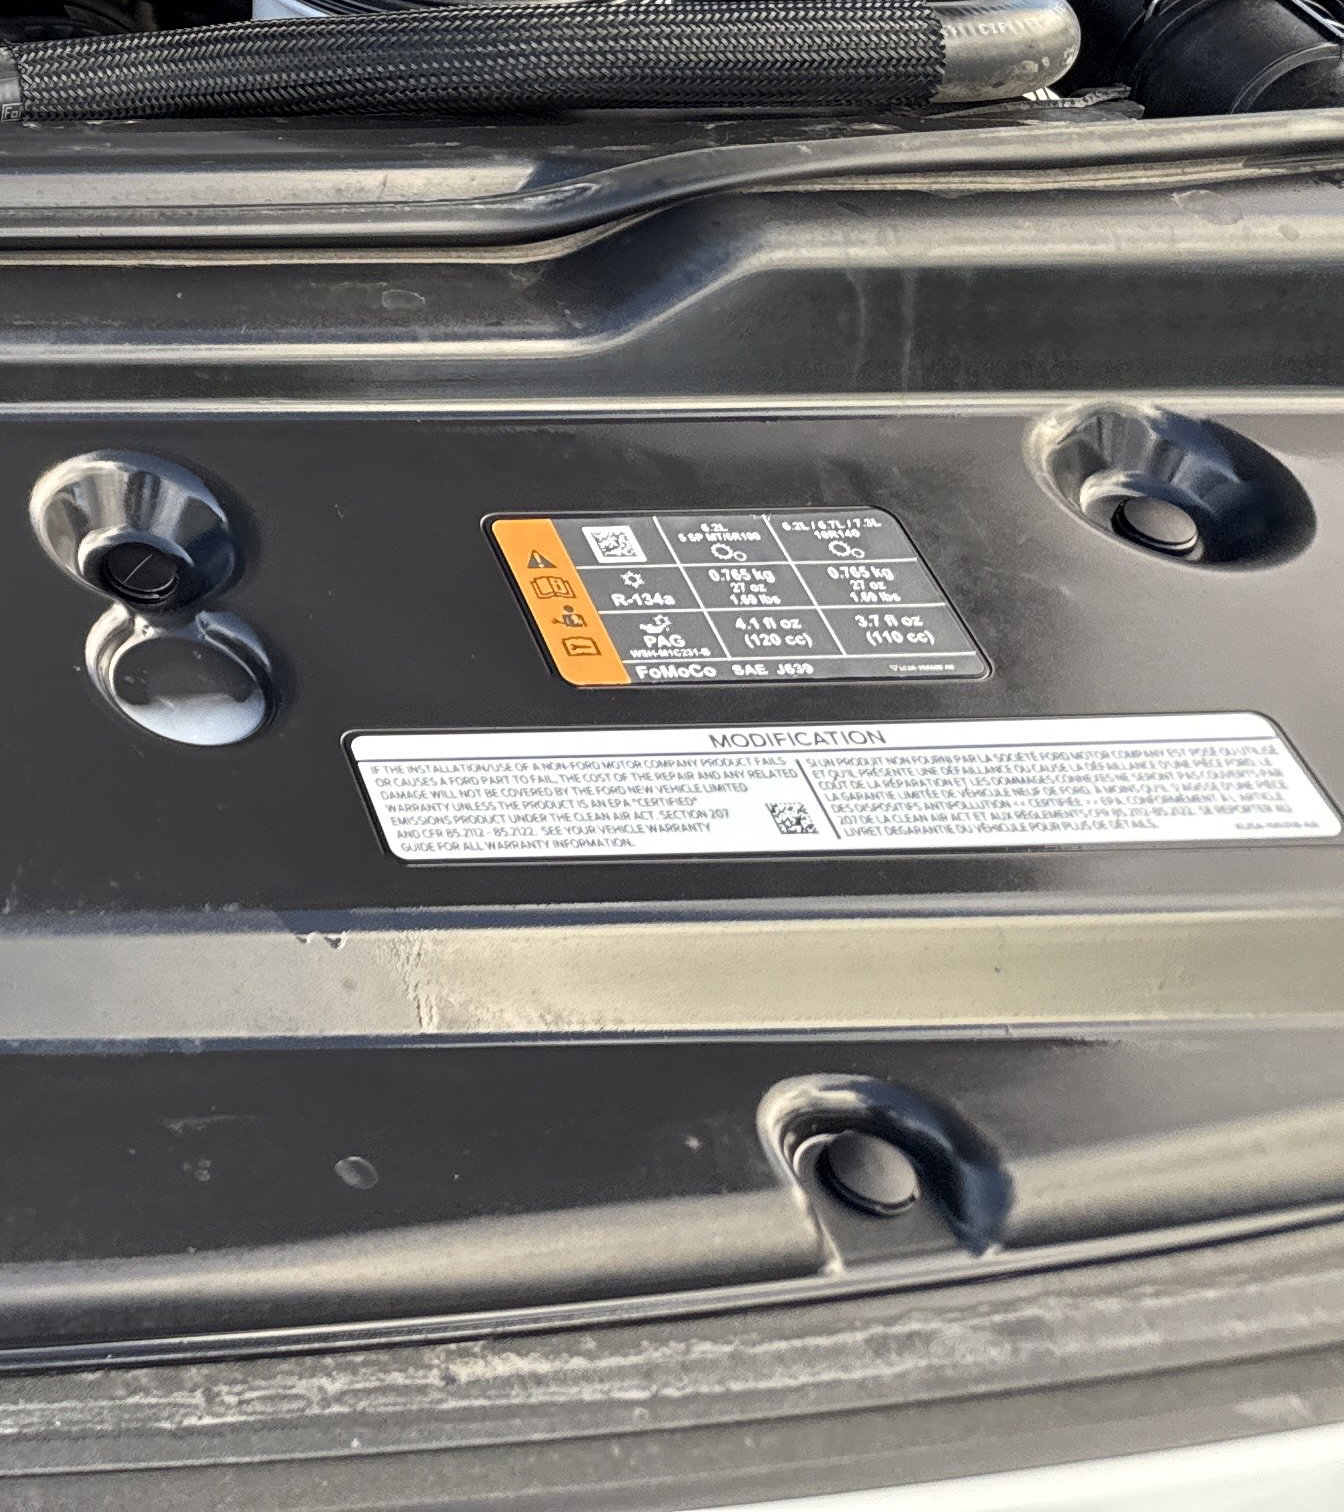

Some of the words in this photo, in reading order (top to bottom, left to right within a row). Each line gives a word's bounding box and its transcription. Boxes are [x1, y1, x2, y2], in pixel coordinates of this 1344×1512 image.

[708, 568, 751, 582] 0.765
[752, 568, 775, 583] kg
[827, 566, 871, 579] 0.765
[872, 566, 895, 581] kg
[730, 582, 745, 593] 27
[749, 584, 767, 593] oz
[850, 580, 865, 590] 27
[869, 581, 887, 590] oz
[611, 592, 676, 607] R-134a
[735, 617, 760, 630] 4.1
[780, 619, 803, 629] oz
[854, 614, 880, 628] 3.7
[900, 616, 924, 627] oz
[643, 634, 686, 648] PAG
[744, 634, 782, 648] (120
[784, 633, 813, 648] cc)
[866, 630, 904, 647] (110
[906, 630, 935, 646] cc)
[635, 665, 717, 680] FoMoCo
[731, 664, 769, 676] SAE
[776, 662, 814, 676] J639
[708, 730, 887, 749] MODIFICATION
[384, 765, 405, 774] THE
[514, 762, 528, 771] OF
[642, 759, 697, 768] COMPANY
[700, 757, 751, 767] PRODUCT
[375, 778, 391, 787] OR
[393, 777, 438, 787] CAUSES
[449, 776, 479, 785] FORD
[481, 776, 510, 785] PART
[514, 775, 529, 784] TO
[558, 774, 580, 783] THE
[582, 773, 611, 783] COST
[613, 773, 628, 782] OF
[630, 773, 653, 782] THE
[654, 772, 694, 781] REPAIR
[696, 771, 721, 780] AND
[723, 771, 744, 780] ANY
[747, 770, 798, 779] RELATED
[380, 790, 427, 800] DAMAGE
[430, 789, 457, 799] WILL
[458, 789, 481, 798] NOT
[484, 789, 499, 798] BE
[500, 787, 552, 797] COVERED
[553, 787, 568, 796] BY
[570, 787, 594, 796] THE
[596, 786, 626, 795] FORD
[628, 785, 653, 795] NEW
[657, 784, 701, 794] VEHICLE
[702, 783, 748, 793] LIMITED
[385, 802, 449, 812] WARRANTY
[451, 801, 496, 811] UNLESS
[498, 801, 520, 810] THE
[522, 800, 573, 809] PRODUCT
[576, 799, 588, 808] IS
[591, 799, 606, 808] AN
[608, 798, 631, 808] EPA
[390, 815, 452, 825] EMISSIONS
[453, 814, 505, 824] PRODUCT
[508, 813, 547, 823] UNDER
[549, 813, 570, 822] THE
[573, 812, 610, 821] CLEAN
[612, 812, 630, 821] AIR
[659, 810, 708, 820] SECTION
[709, 809, 729, 819] 207
[396, 829, 420, 839] AND
[421, 829, 443, 838] CFR
[540, 826, 562, 835] SEE
[564, 825, 596, 835] YOUR
[597, 824, 644, 834] VEHICLE
[647, 823, 710, 833] WARRANTY
[400, 842, 435, 852] GUIDE
[436, 842, 459, 851] FOR
[462, 841, 482, 851] ALL
[484, 840, 550, 850] WARRANTY
